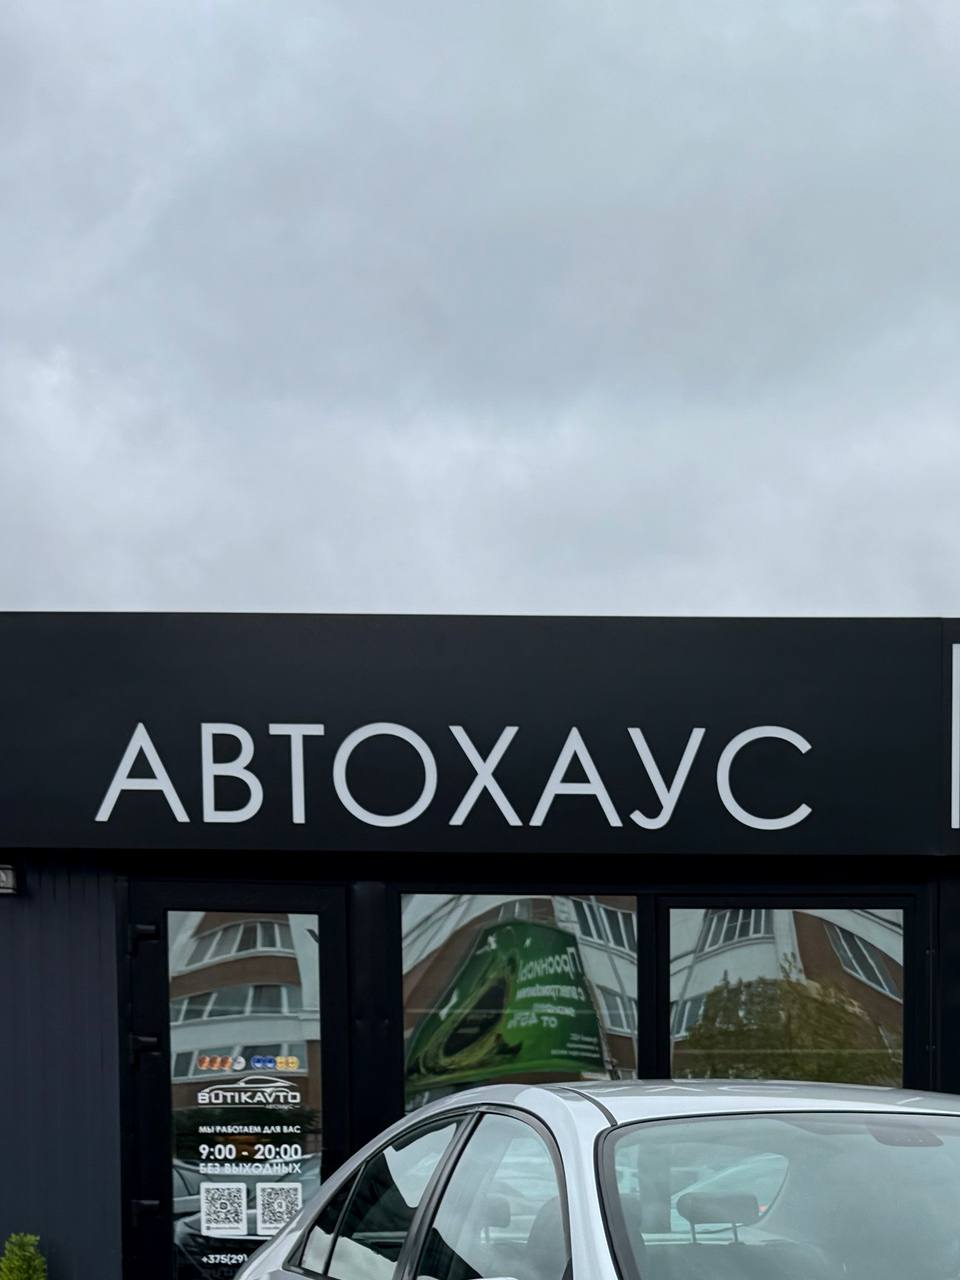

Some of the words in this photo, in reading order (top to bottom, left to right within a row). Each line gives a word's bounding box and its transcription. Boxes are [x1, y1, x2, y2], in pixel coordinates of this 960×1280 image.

[96, 722, 812, 830] АВТОХАУС
[197, 1091, 301, 1104] BUTIKAVTO
[199, 1125, 215, 1134] МЫ
[215, 1125, 262, 1134] РАБОТАЕМ
[262, 1125, 281, 1134] ДЛЯ
[282, 1125, 301, 1134] ВАС
[199, 1144, 236, 1160] 9:00
[254, 1144, 302, 1160] 20:00
[199, 1162, 222, 1174] БЕЗ
[224, 1162, 301, 1174] ВЫХОДНЫХ
